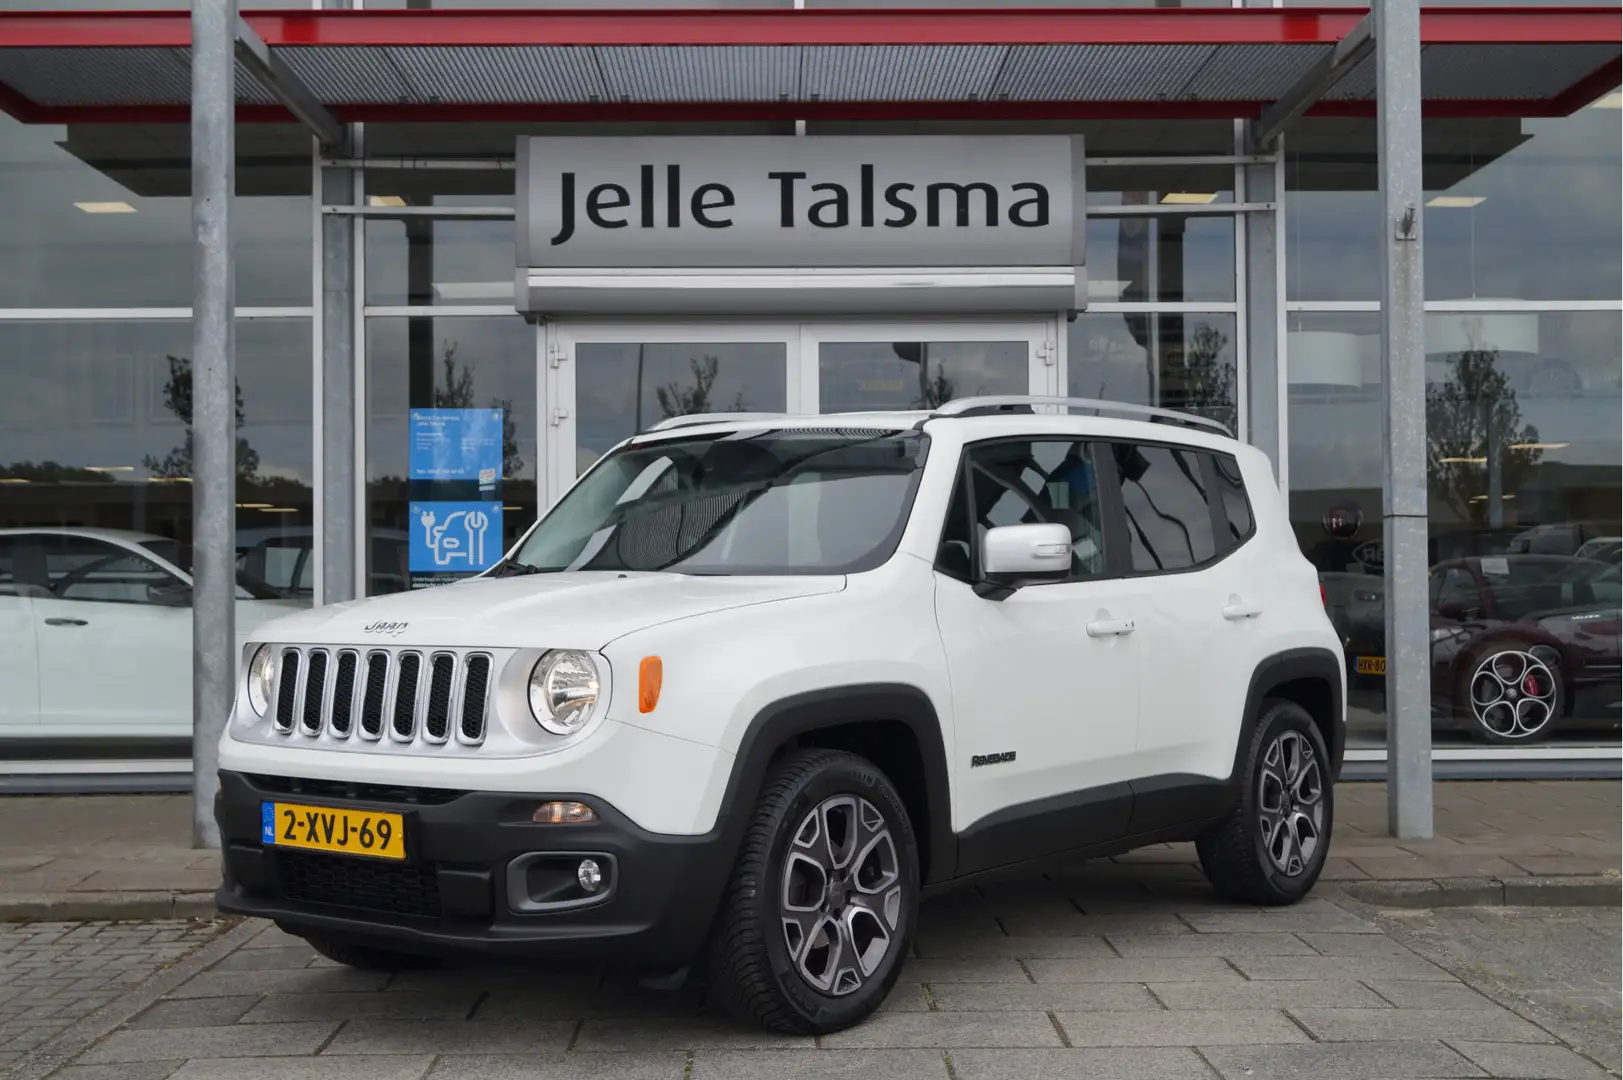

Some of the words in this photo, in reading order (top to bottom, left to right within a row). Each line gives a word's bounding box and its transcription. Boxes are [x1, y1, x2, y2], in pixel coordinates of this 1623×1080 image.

[551, 164, 735, 245] Jelle
[768, 163, 1049, 228] Talsma
[364, 619, 410, 637] Jeep
[971, 751, 1016, 768] RENEGADE
[264, 826, 274, 836] NL
[283, 810, 392, 849] 2-XVJ-69
